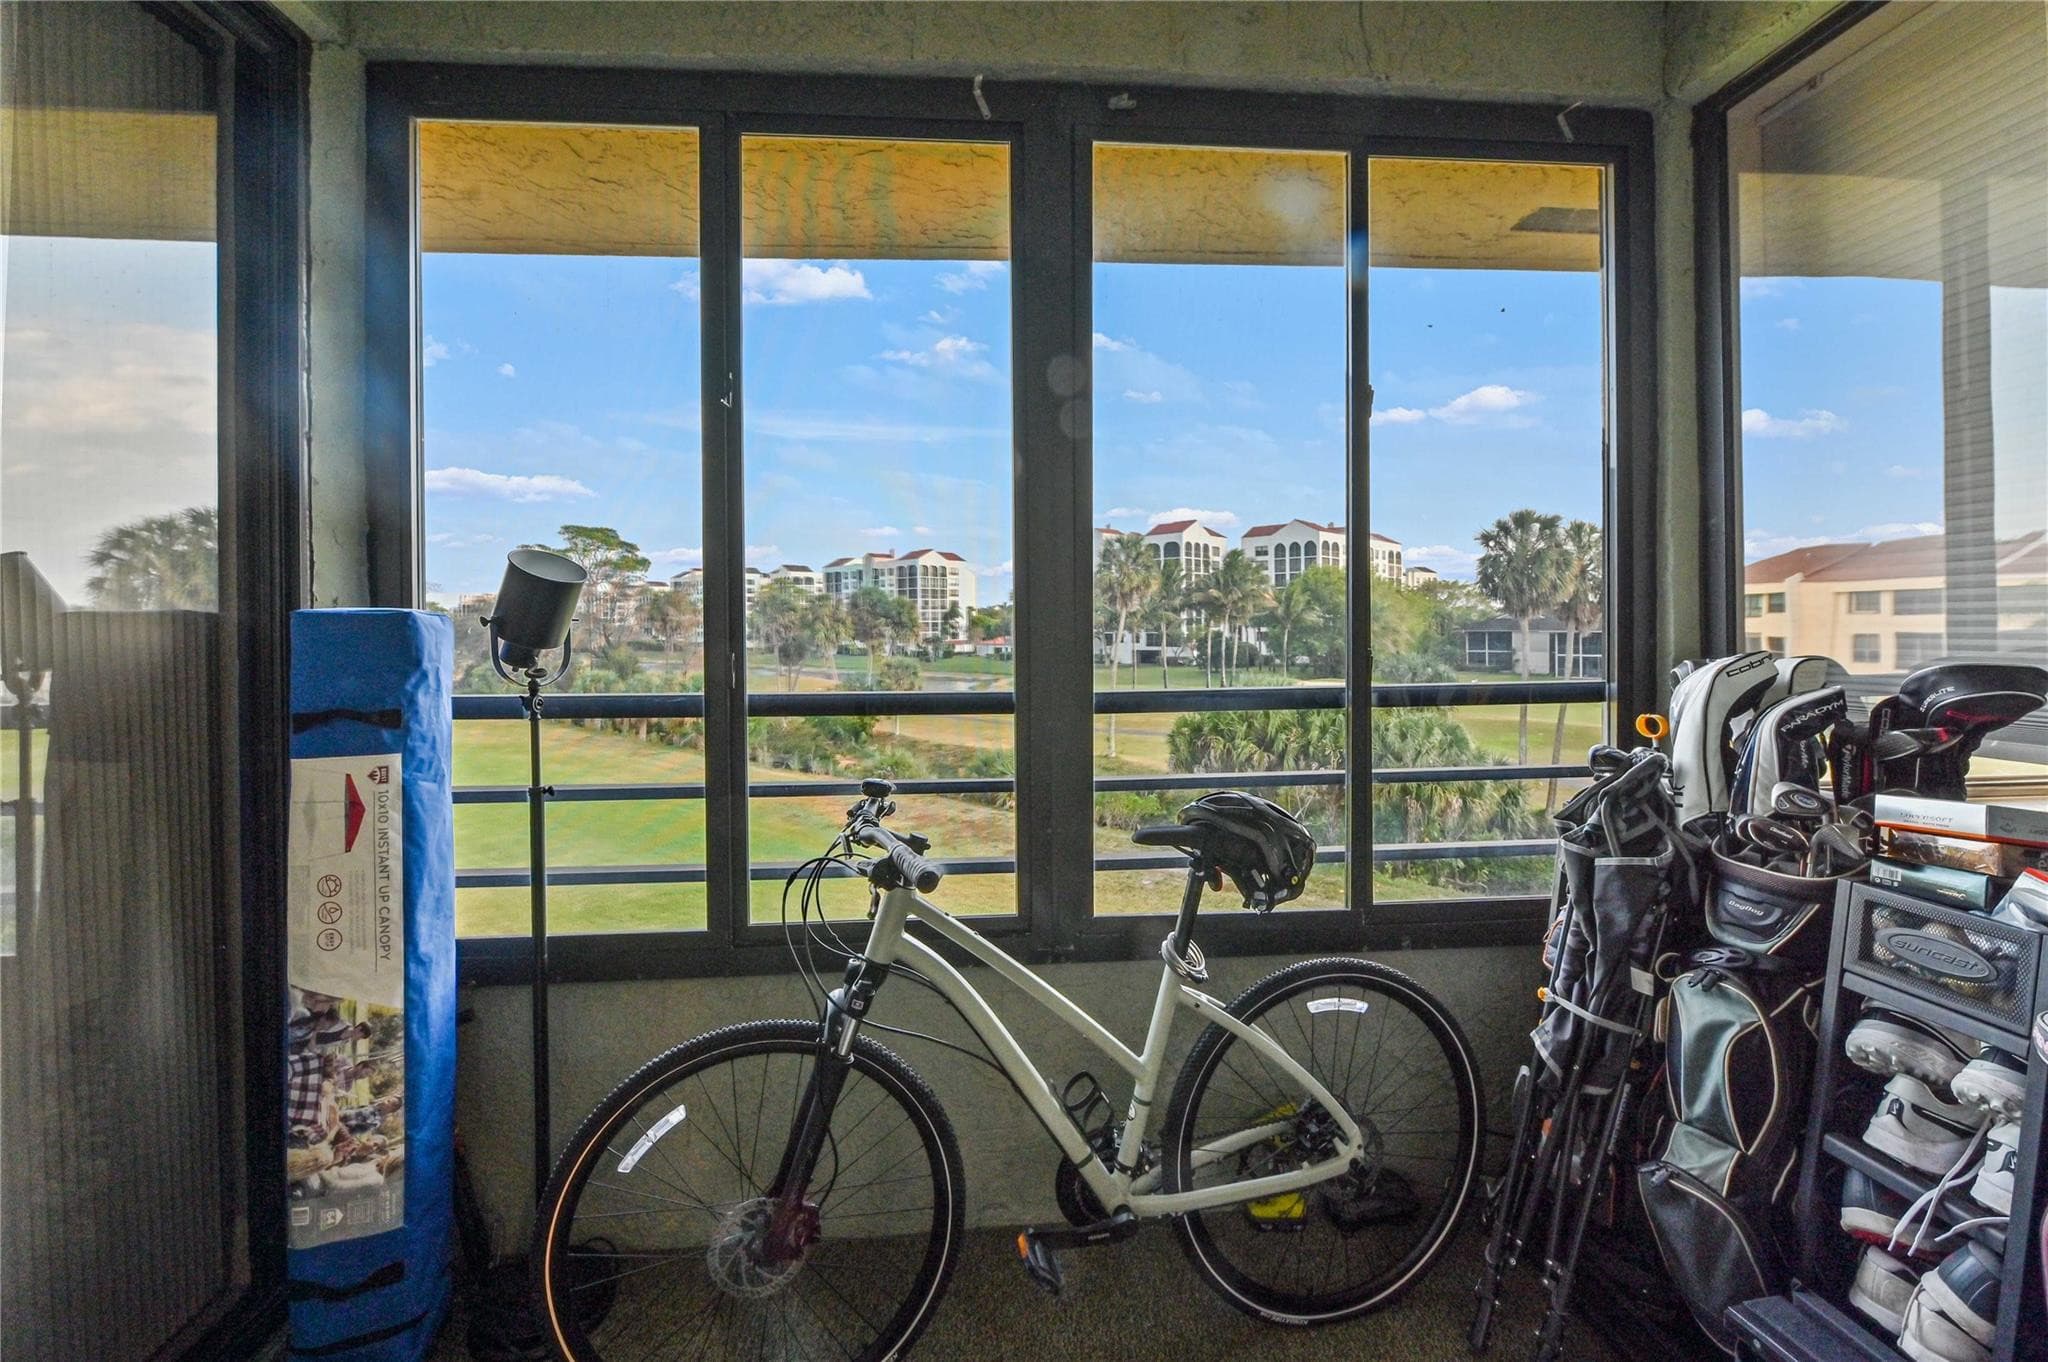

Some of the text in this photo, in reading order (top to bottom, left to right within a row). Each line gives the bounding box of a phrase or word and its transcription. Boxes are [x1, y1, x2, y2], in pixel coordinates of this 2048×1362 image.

[1780, 699, 1844, 733] PARADYM
[378, 827, 390, 881] INSTANT
[378, 886, 390, 903] UP
[379, 906, 392, 961] CANOPY
[1894, 940, 1979, 970] suncast
